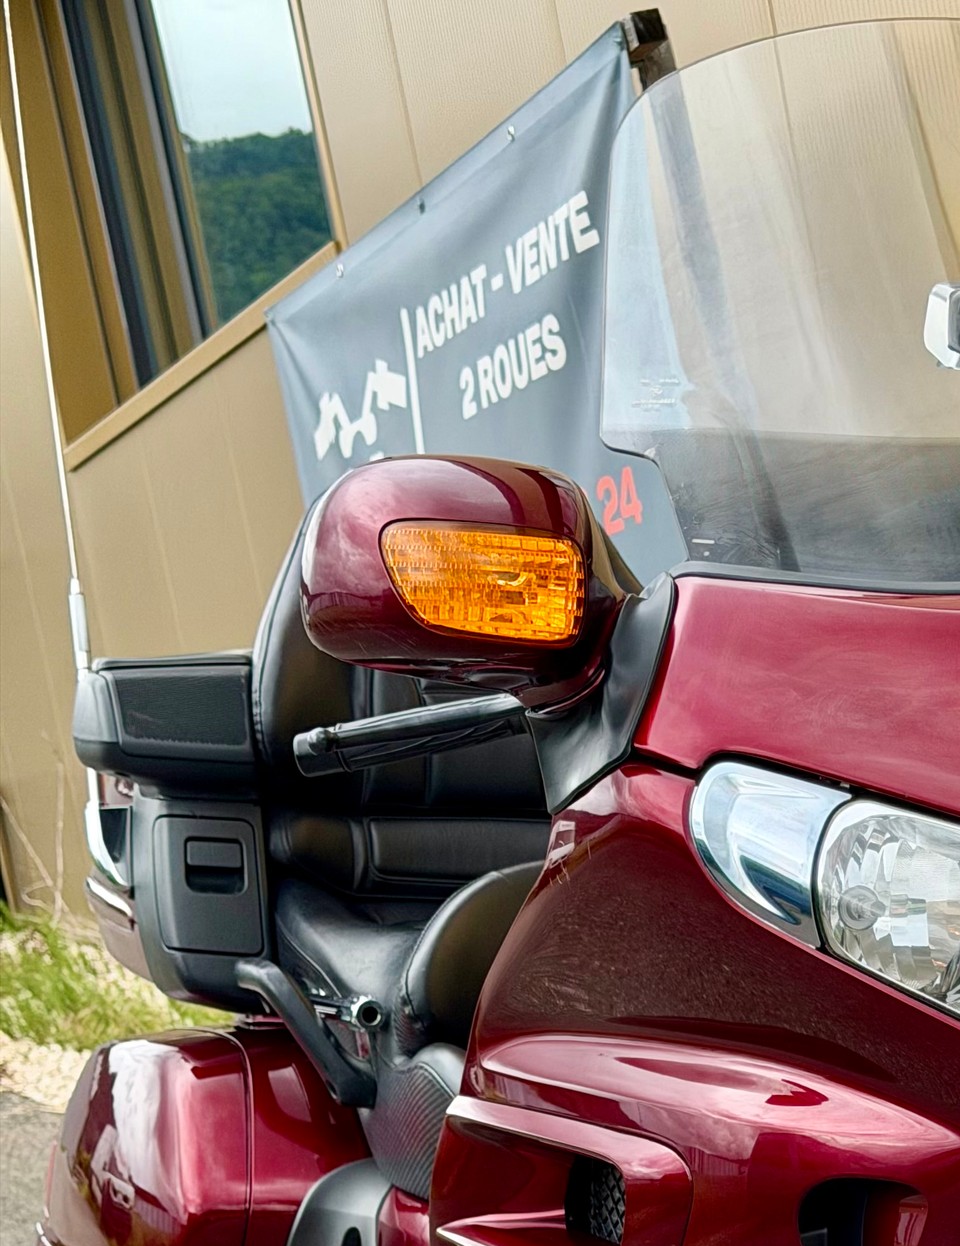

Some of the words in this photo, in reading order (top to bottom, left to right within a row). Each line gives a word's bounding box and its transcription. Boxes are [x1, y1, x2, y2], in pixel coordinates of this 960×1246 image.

[415, 263, 488, 358] ACHAT
[504, 190, 600, 294] VENTE
[458, 366, 478, 421] 2
[476, 313, 567, 411] ROUES
[596, 465, 644, 537] 24
